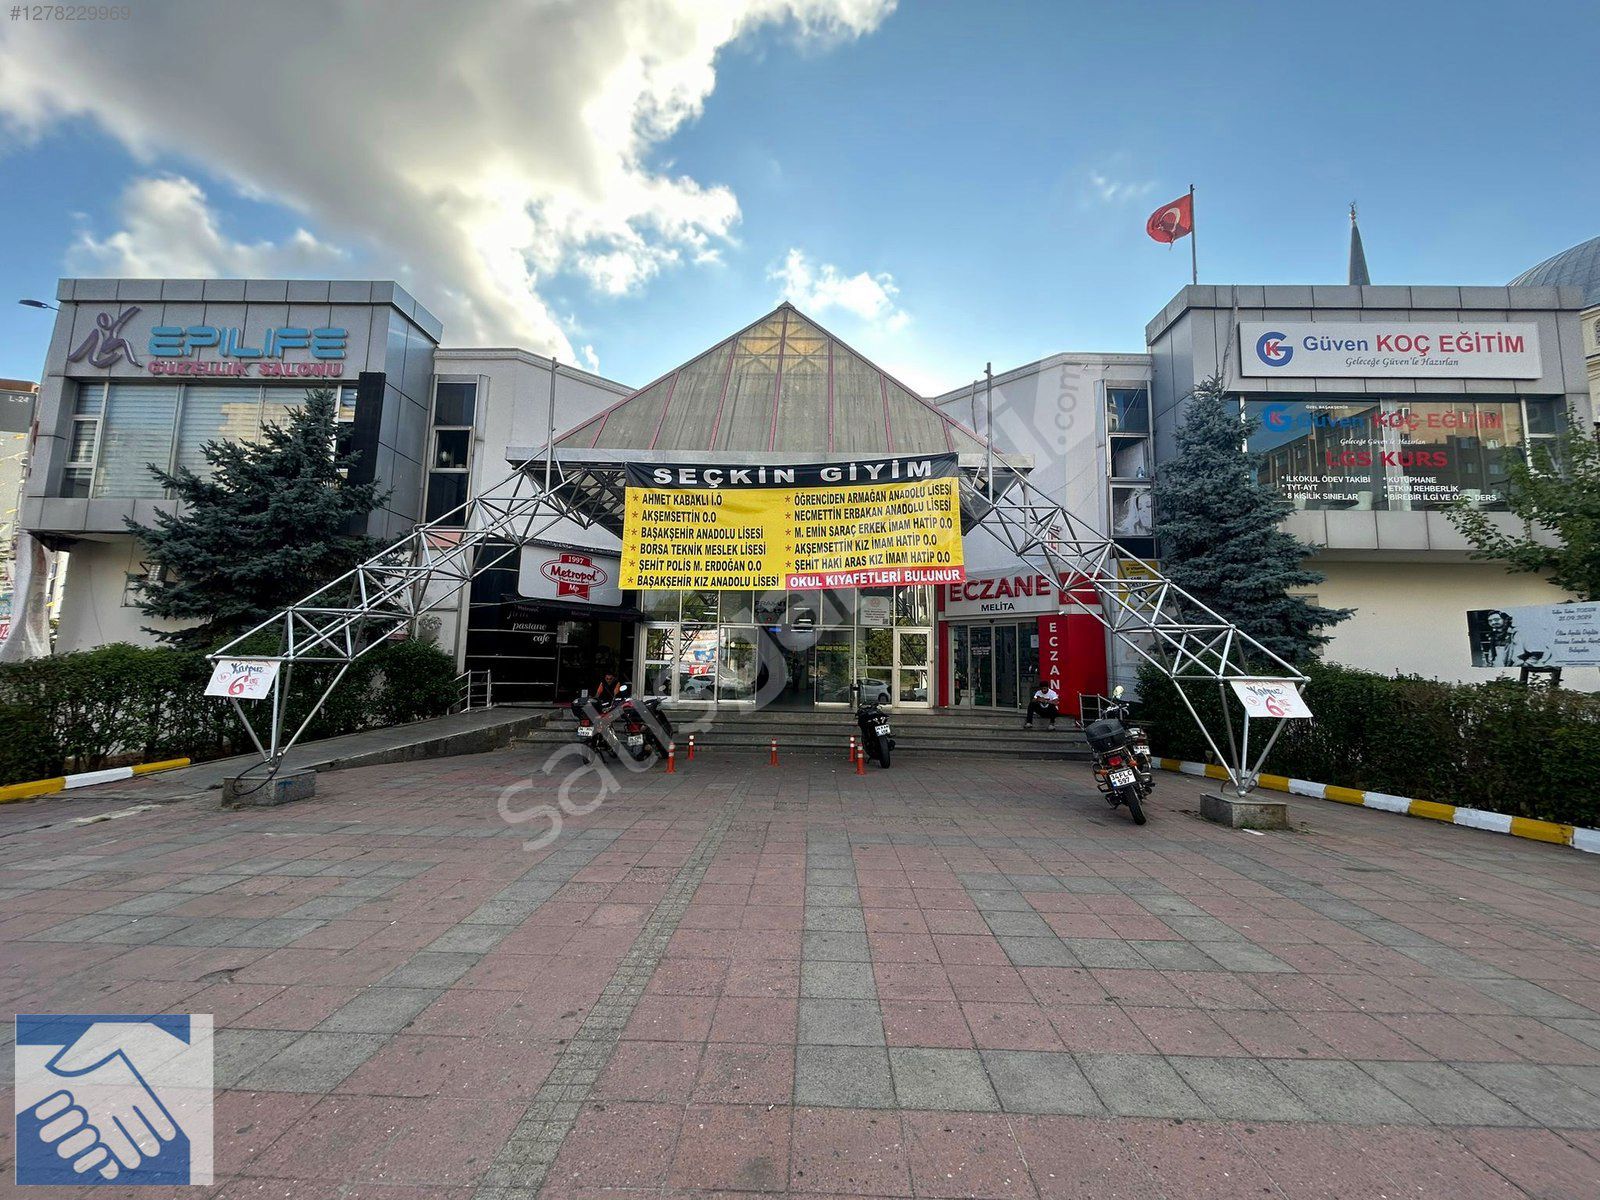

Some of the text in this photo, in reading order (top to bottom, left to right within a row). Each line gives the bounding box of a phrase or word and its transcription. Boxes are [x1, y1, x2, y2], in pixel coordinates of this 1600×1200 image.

[149, 326, 348, 359] EPILIFE
[1302, 331, 1524, 357] Güven KOÇ EĞİTİM
[259, 362, 345, 377] SALONU
[1345, 356, 1459, 368] Geleceğe Güven'le Hazırlan
[1298, 410, 1503, 431] Güven KOÇ EĞİTİM
[1326, 450, 1448, 468] LGS KURS
[653, 459, 932, 488] SEÇKİN GİYİM
[1286, 474, 1371, 483] İLKOKUL ÖDEV TAKİBİ
[794, 481, 952, 506] ÖĞRENCİDEN ARMAĞAN ANADOLU LİSESİ
[1414, 484, 1458, 492] REHBERLİK
[642, 494, 671, 506] AHMET
[674, 494, 709, 506] KABAKLI
[1286, 492, 1292, 500] 8
[1293, 492, 1321, 501] KİŞİLİK
[1423, 492, 1438, 500] İLGİ
[642, 509, 700, 524] AKŞEMSETTİN
[794, 497, 951, 522] NECMETTİN ERBAKAN ANADOLU LİSESİ
[641, 525, 764, 541] BAŞAKŞEHİR ANADOLU LİSESİ
[794, 527, 804, 538] M.
[806, 524, 827, 538] EMİN
[829, 524, 856, 537] SARAÇ
[858, 522, 886, 534] ERKEK
[888, 517, 911, 532] İMAM
[914, 514, 937, 530] HATİP
[640, 542, 766, 556] BORSA TEKNİK MESLEK LİSESİ
[794, 536, 853, 556] AKŞEMSETTİN
[856, 540, 870, 550] KIZ
[872, 536, 894, 550] İMAM
[896, 532, 920, 547] HATİP
[568, 556, 584, 564] 1997
[638, 558, 664, 573] ŞEHİT
[666, 558, 691, 571] POLİS
[694, 560, 703, 571] M.
[705, 558, 745, 571] ERDOĞAN
[794, 558, 819, 573] ŞEHİT
[844, 555, 866, 567] ARAS
[868, 553, 884, 565] KIZ
[886, 550, 908, 564] İMAM
[910, 548, 934, 563] HATİP
[550, 565, 597, 582] Metropol
[637, 574, 779, 588] BAŞAKŞEHİR KIZ ANADOLU LİSESİ
[790, 570, 960, 588] OKUL KIYAFETLERİ BULUNUR
[950, 574, 1051, 602] ECZANE
[980, 601, 1015, 612] MELİTA
[512, 622, 548, 632] pastane
[532, 633, 550, 644] cafe
[1049, 622, 1060, 709] ECZAN
